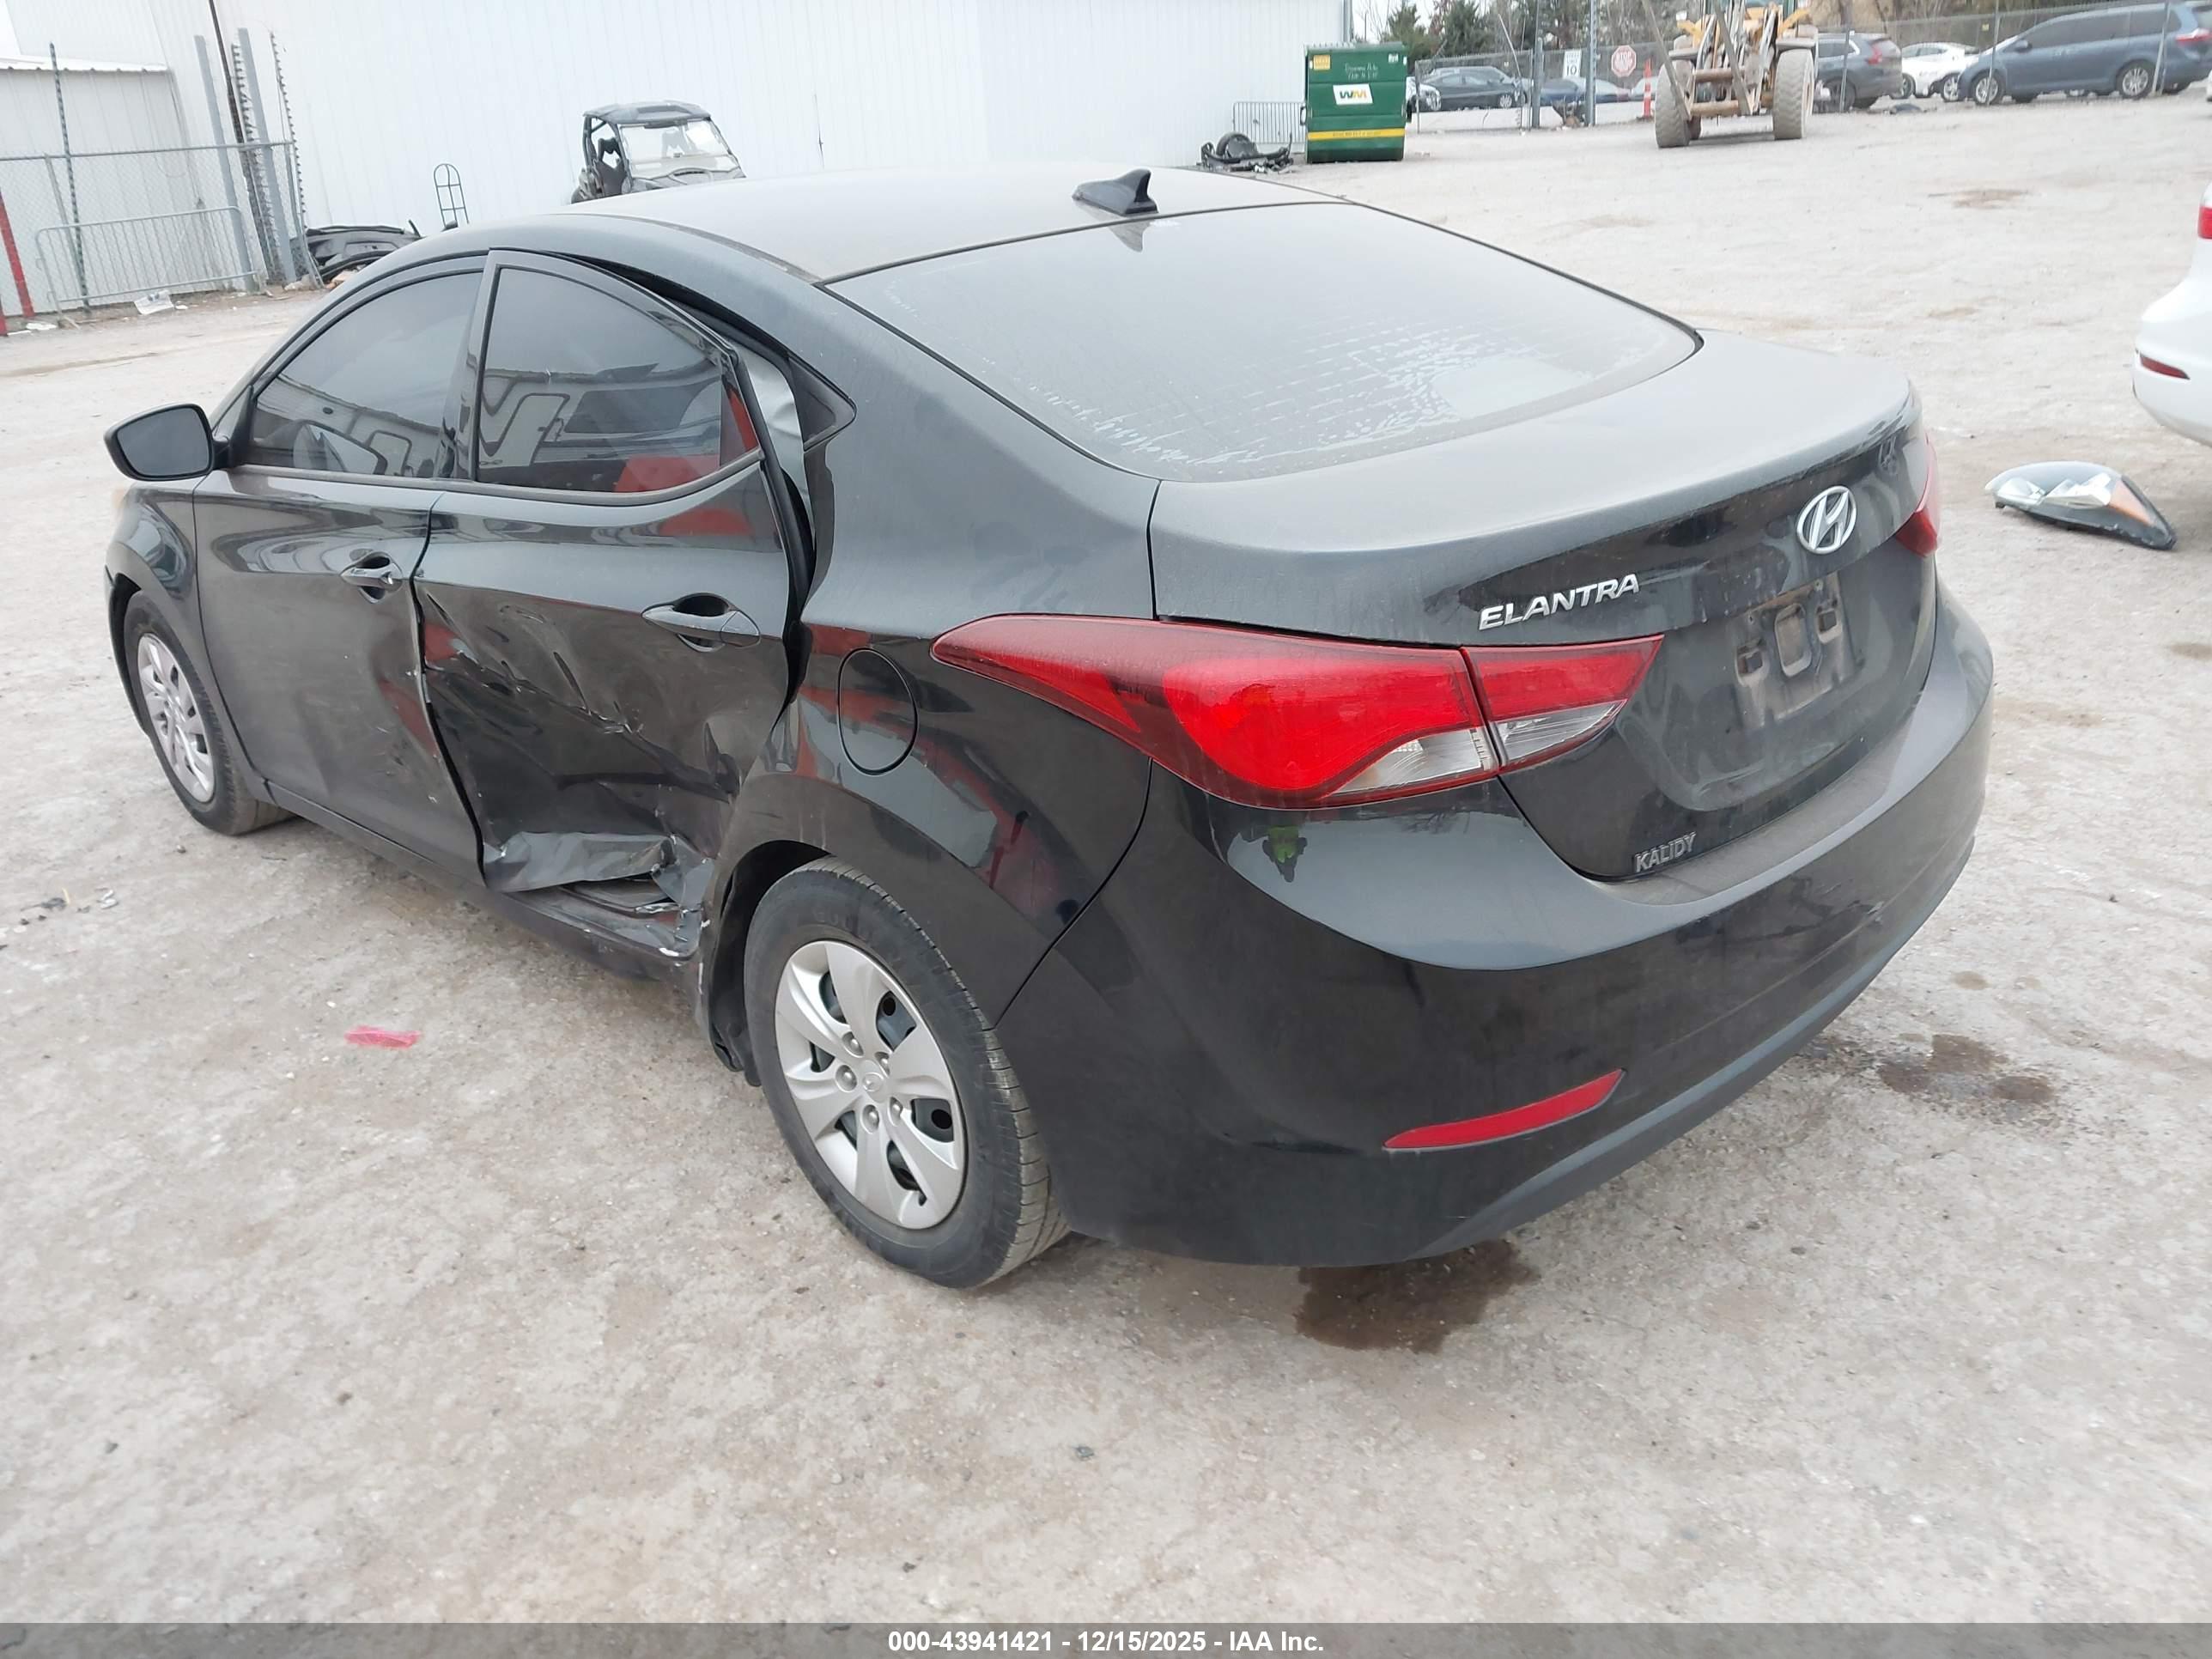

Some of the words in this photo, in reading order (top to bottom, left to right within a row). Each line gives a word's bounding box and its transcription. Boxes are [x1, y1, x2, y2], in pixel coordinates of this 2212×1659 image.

[1566, 65, 1577, 76] 10
[1339, 89, 1368, 99] WM
[1479, 573, 1640, 631] ELANTRA
[1634, 830, 1697, 873] KALIDY
